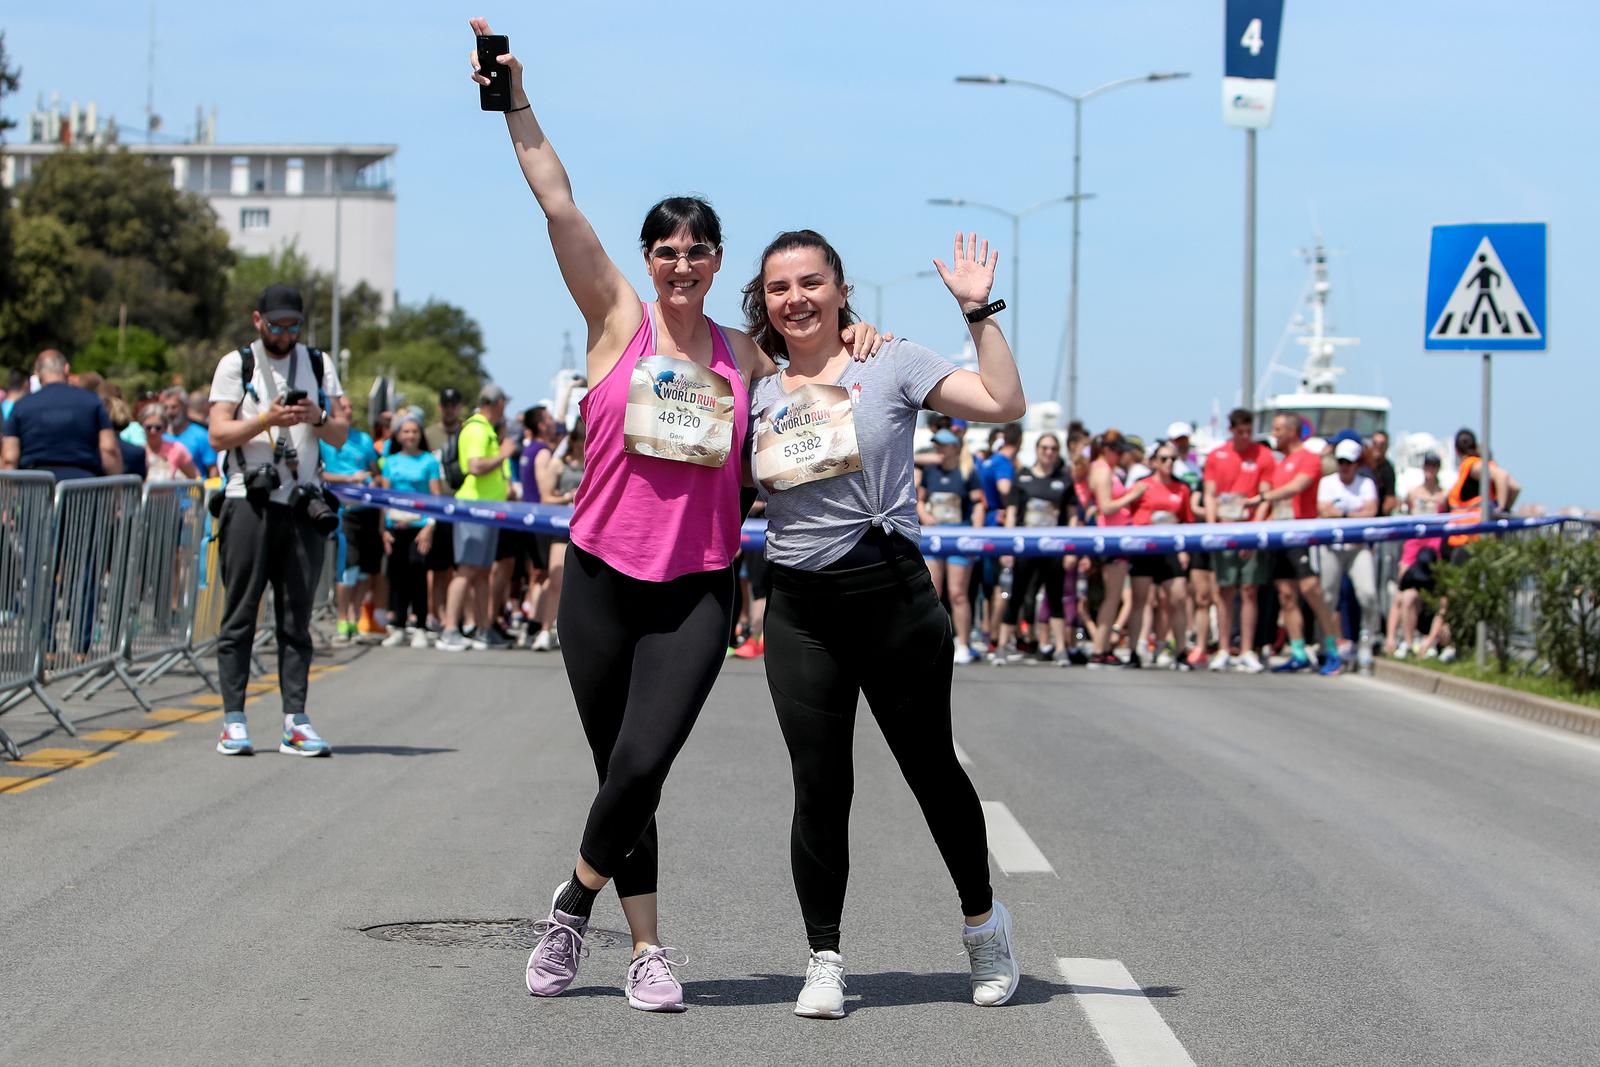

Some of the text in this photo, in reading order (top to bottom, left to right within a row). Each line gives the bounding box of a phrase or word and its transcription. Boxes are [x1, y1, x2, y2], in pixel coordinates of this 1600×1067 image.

[1240, 18, 1264, 57] 4
[658, 411, 701, 429] 48120
[784, 436, 822, 458] 53382
[929, 535, 942, 552] 3
[1013, 535, 1025, 553] 3
